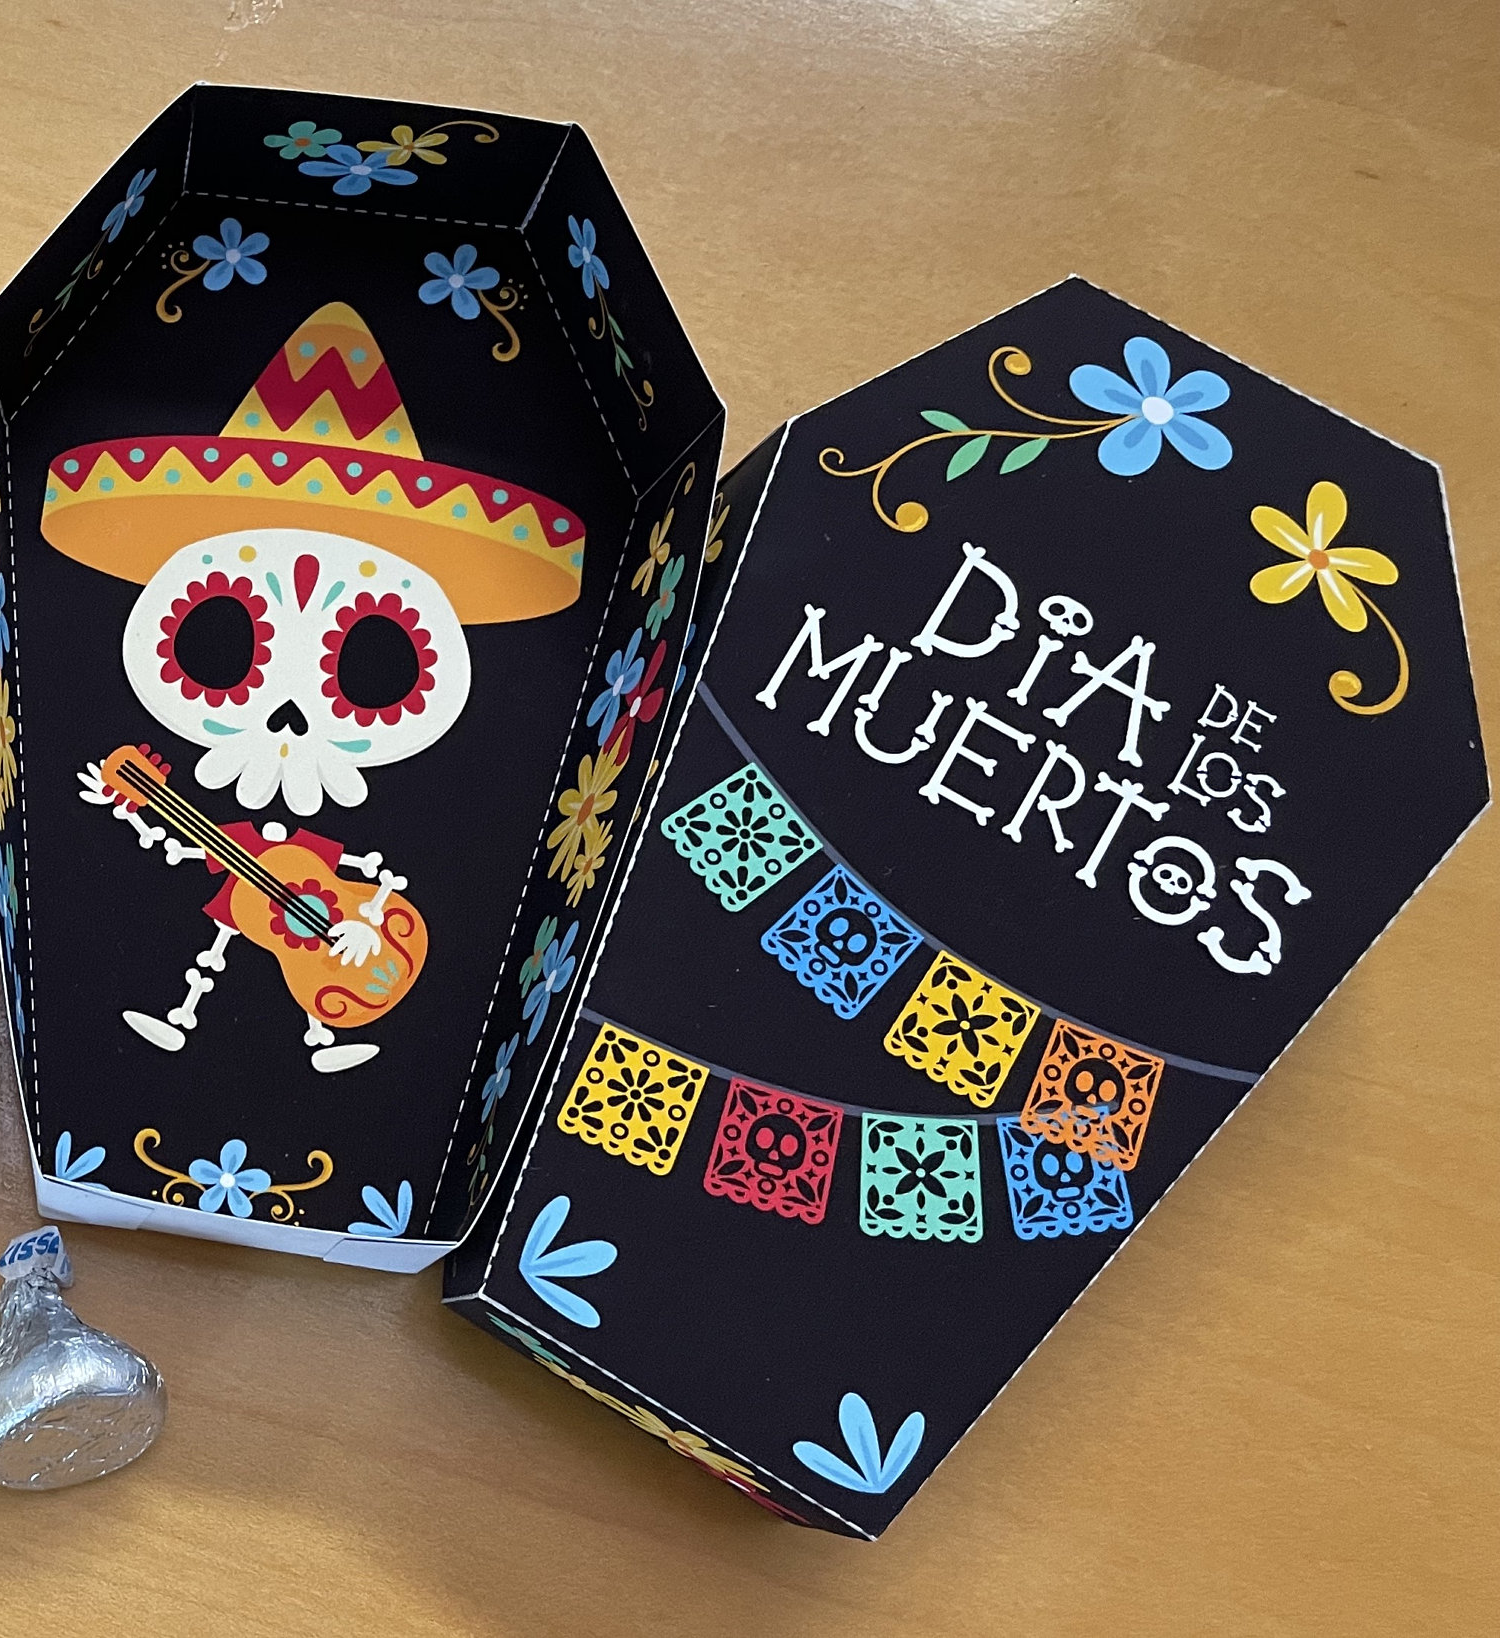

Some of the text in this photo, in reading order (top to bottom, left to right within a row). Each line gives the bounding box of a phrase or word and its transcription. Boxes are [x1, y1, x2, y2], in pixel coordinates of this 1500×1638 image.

[1198, 684, 1278, 753] DE
[756, 604, 1312, 976] MUERTOS
[1167, 733, 1287, 833] LOS
